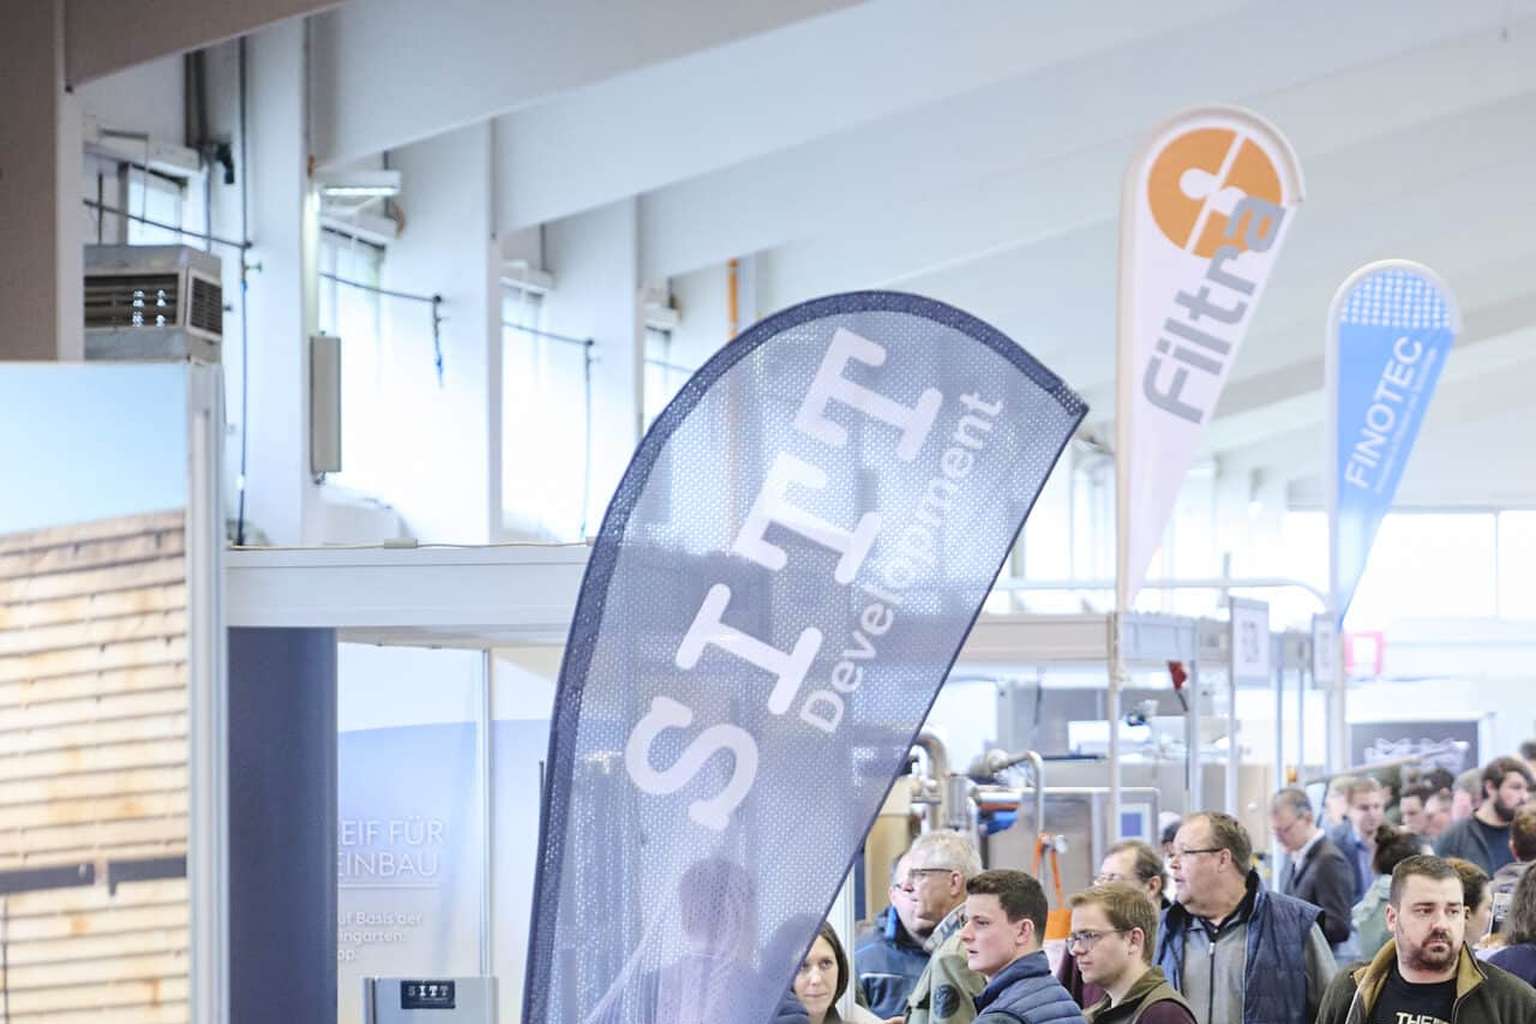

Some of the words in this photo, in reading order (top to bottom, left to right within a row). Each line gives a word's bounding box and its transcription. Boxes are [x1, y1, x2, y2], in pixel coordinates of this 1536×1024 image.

[1344, 336, 1423, 490] FINOTEC
[625, 327, 943, 832] SITT
[800, 391, 1003, 733] Development
[338, 820, 379, 846] EIF
[389, 815, 444, 846] FÜR
